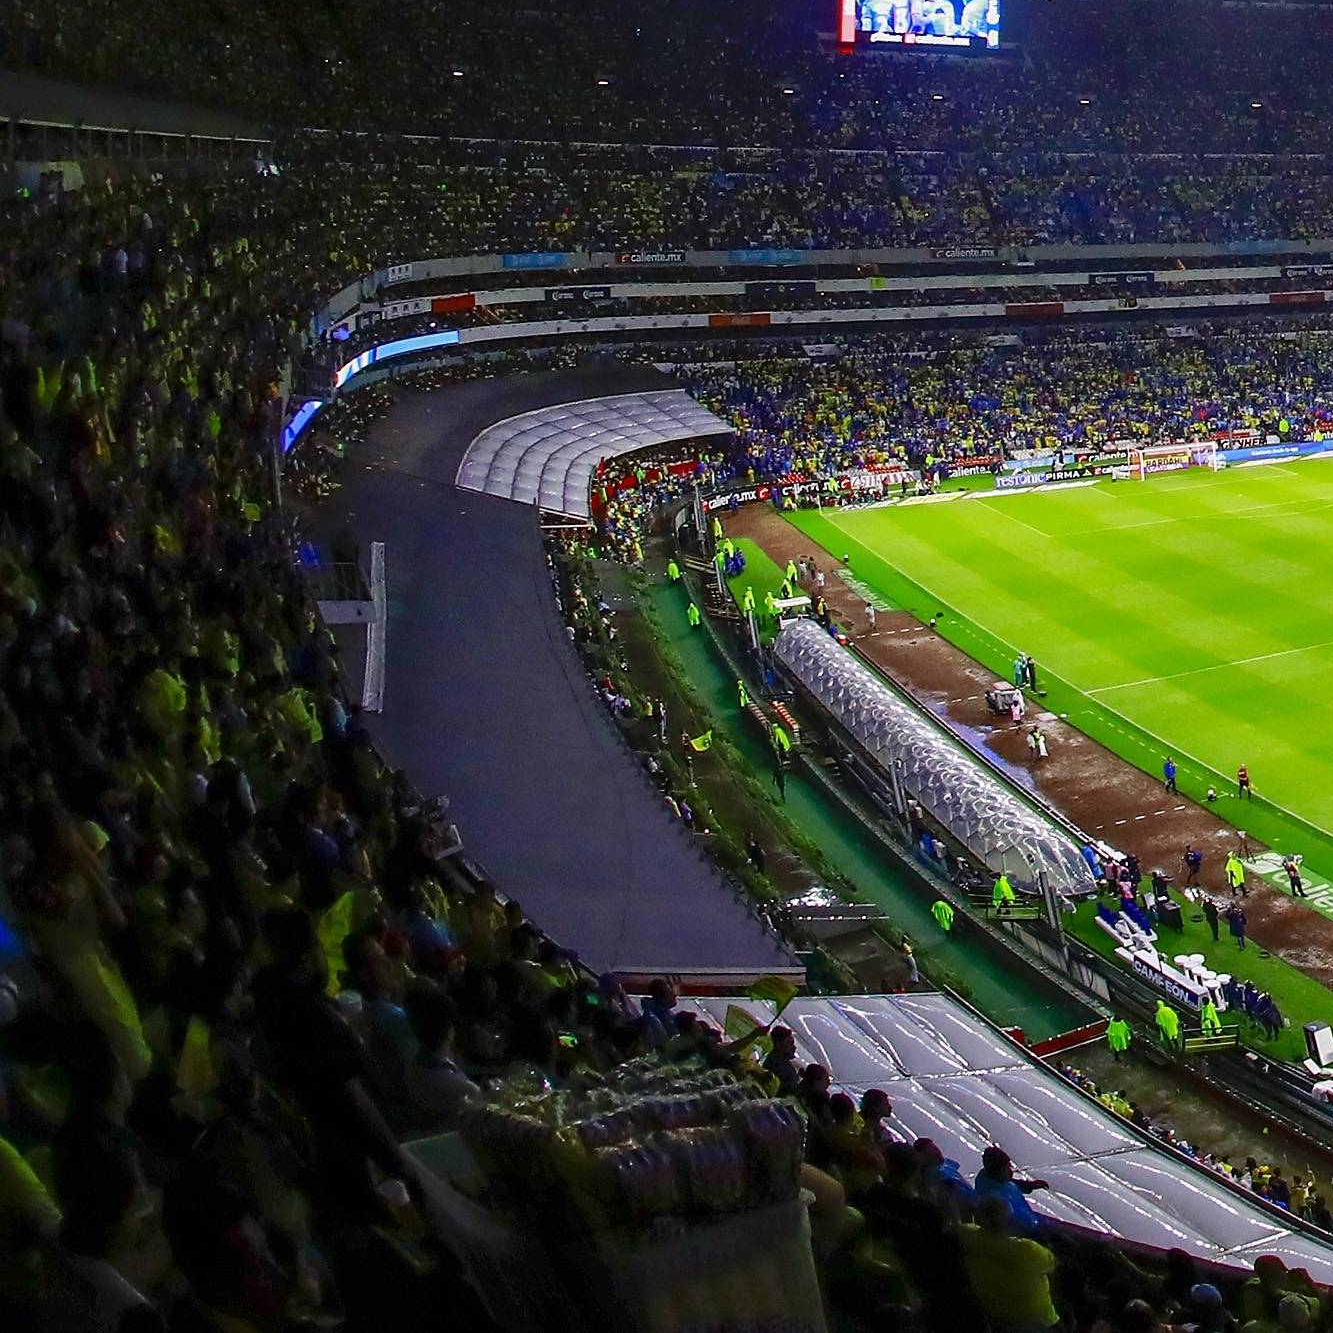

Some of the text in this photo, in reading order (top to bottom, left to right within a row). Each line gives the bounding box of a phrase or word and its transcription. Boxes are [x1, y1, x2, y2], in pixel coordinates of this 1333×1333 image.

[631, 251, 682, 264] caliente.mx
[945, 247, 995, 258] caliente.mx
[1046, 468, 1081, 481] PIRMA
